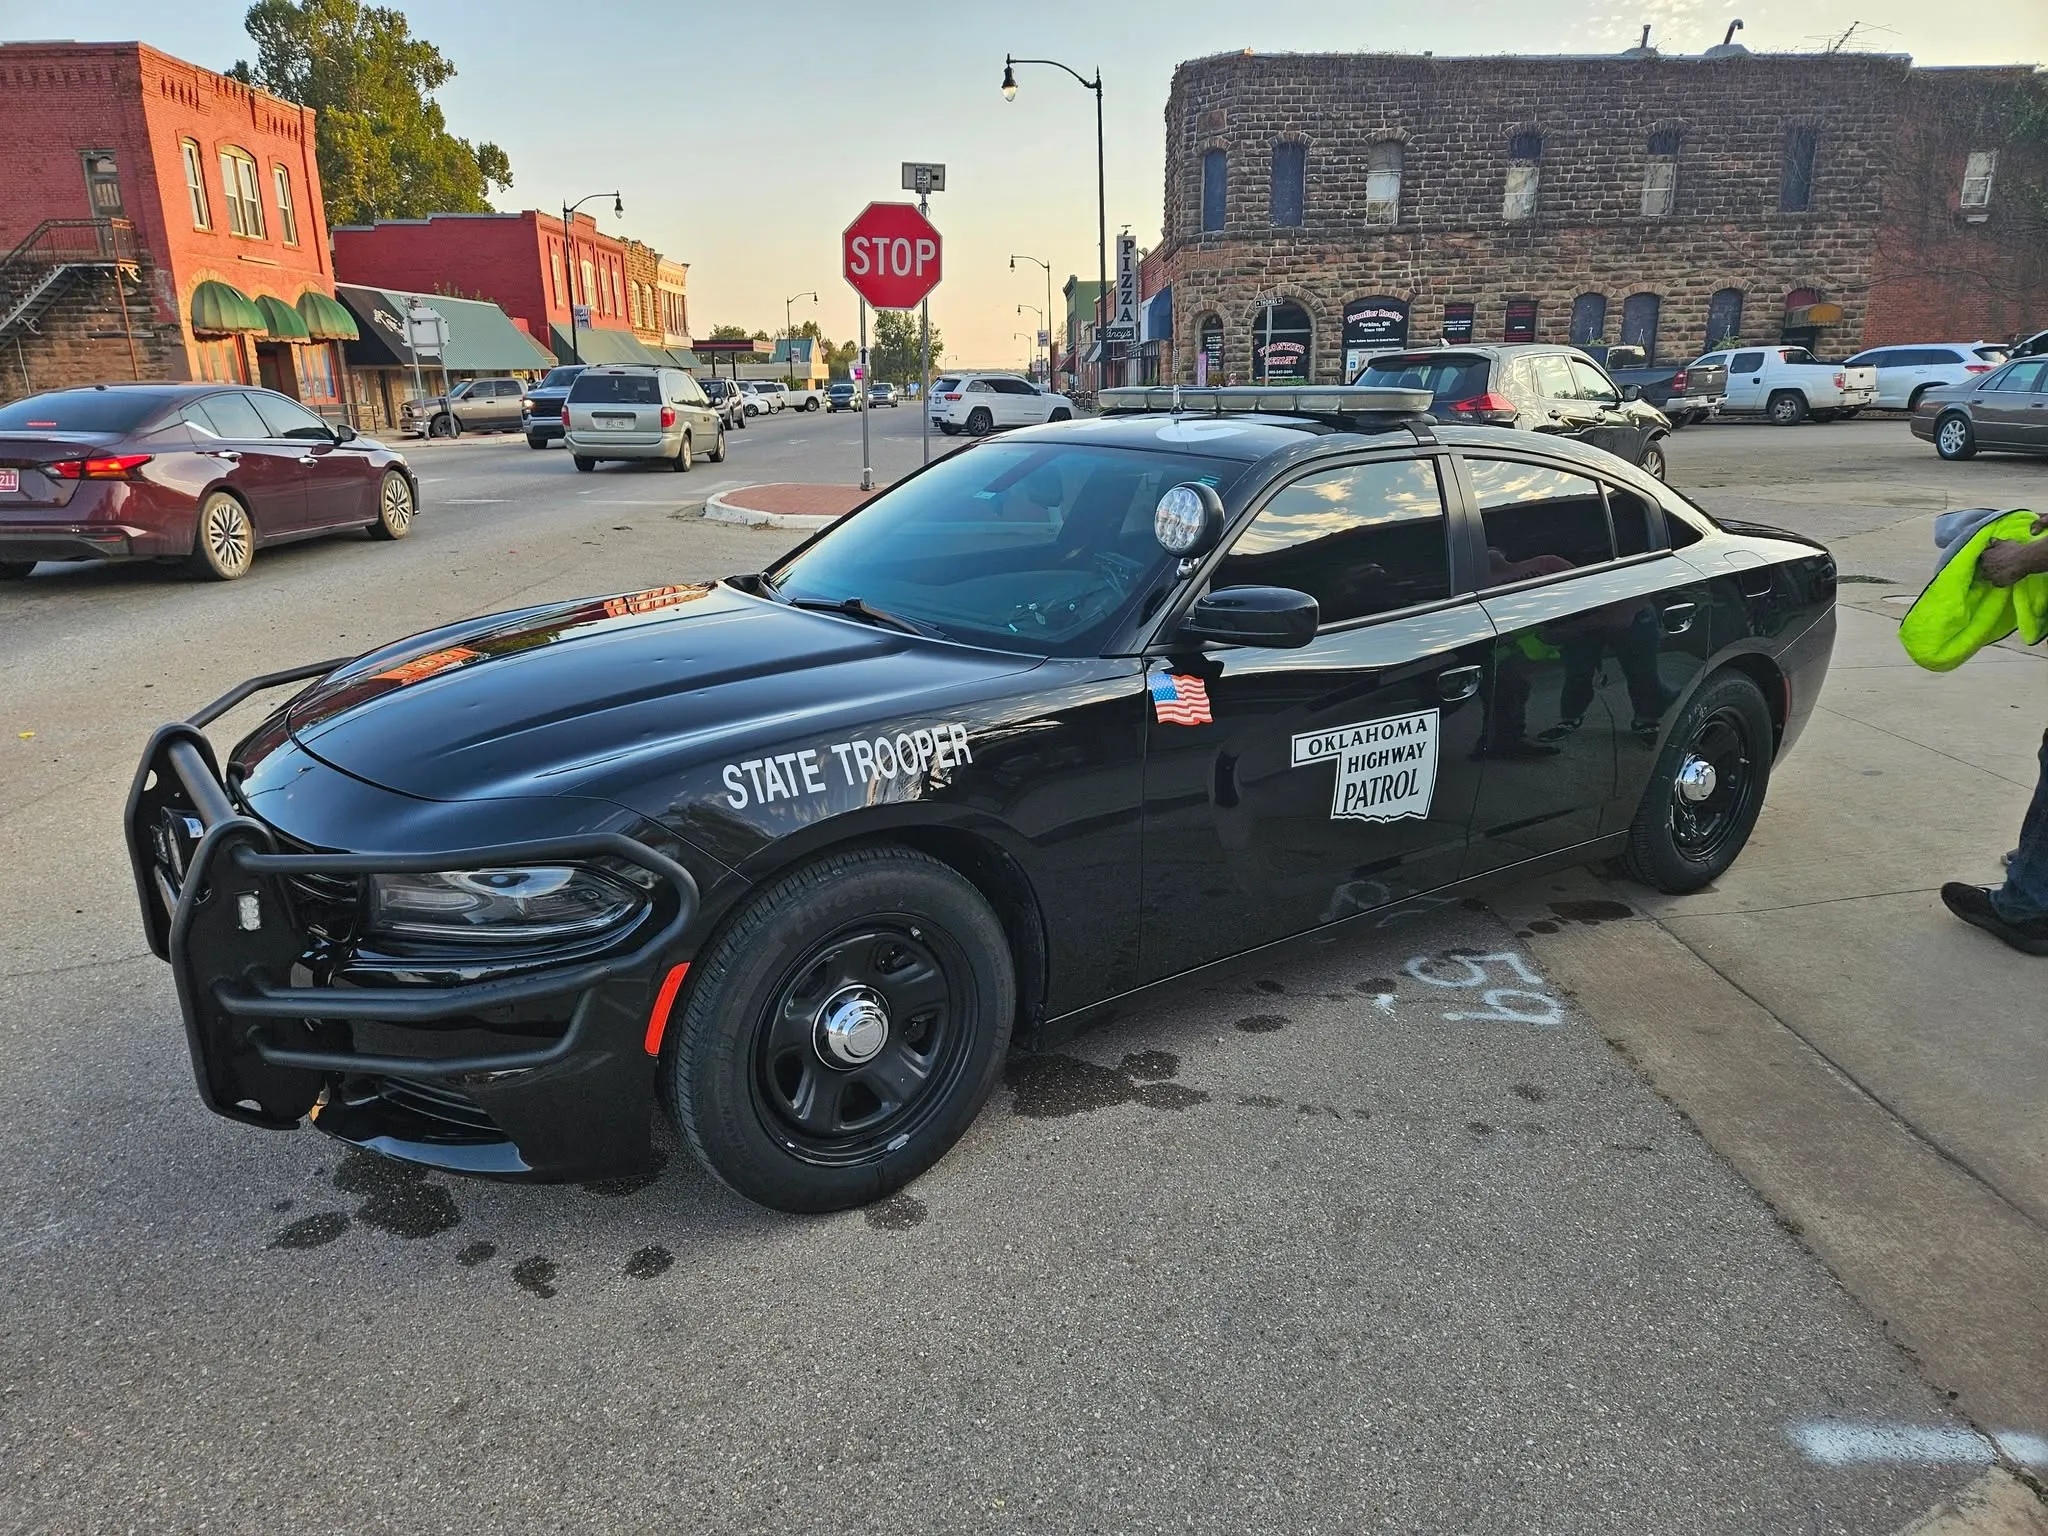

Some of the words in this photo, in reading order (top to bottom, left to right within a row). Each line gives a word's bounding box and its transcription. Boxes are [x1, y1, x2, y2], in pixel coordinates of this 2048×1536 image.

[850, 236, 936, 277] STOP
[1119, 239, 1135, 322] PIZZA
[1097, 328, 1132, 339] ancy's
[1347, 309, 1378, 324] Frontier
[1378, 308, 1404, 322] Realty
[1263, 355, 1299, 366] EALTY
[1308, 718, 1428, 756] OKLAHOMA
[722, 749, 827, 810] STATE
[831, 722, 973, 786] TROOPER
[1347, 741, 1427, 774] HIGHWAY
[1342, 768, 1420, 813] PATROL
